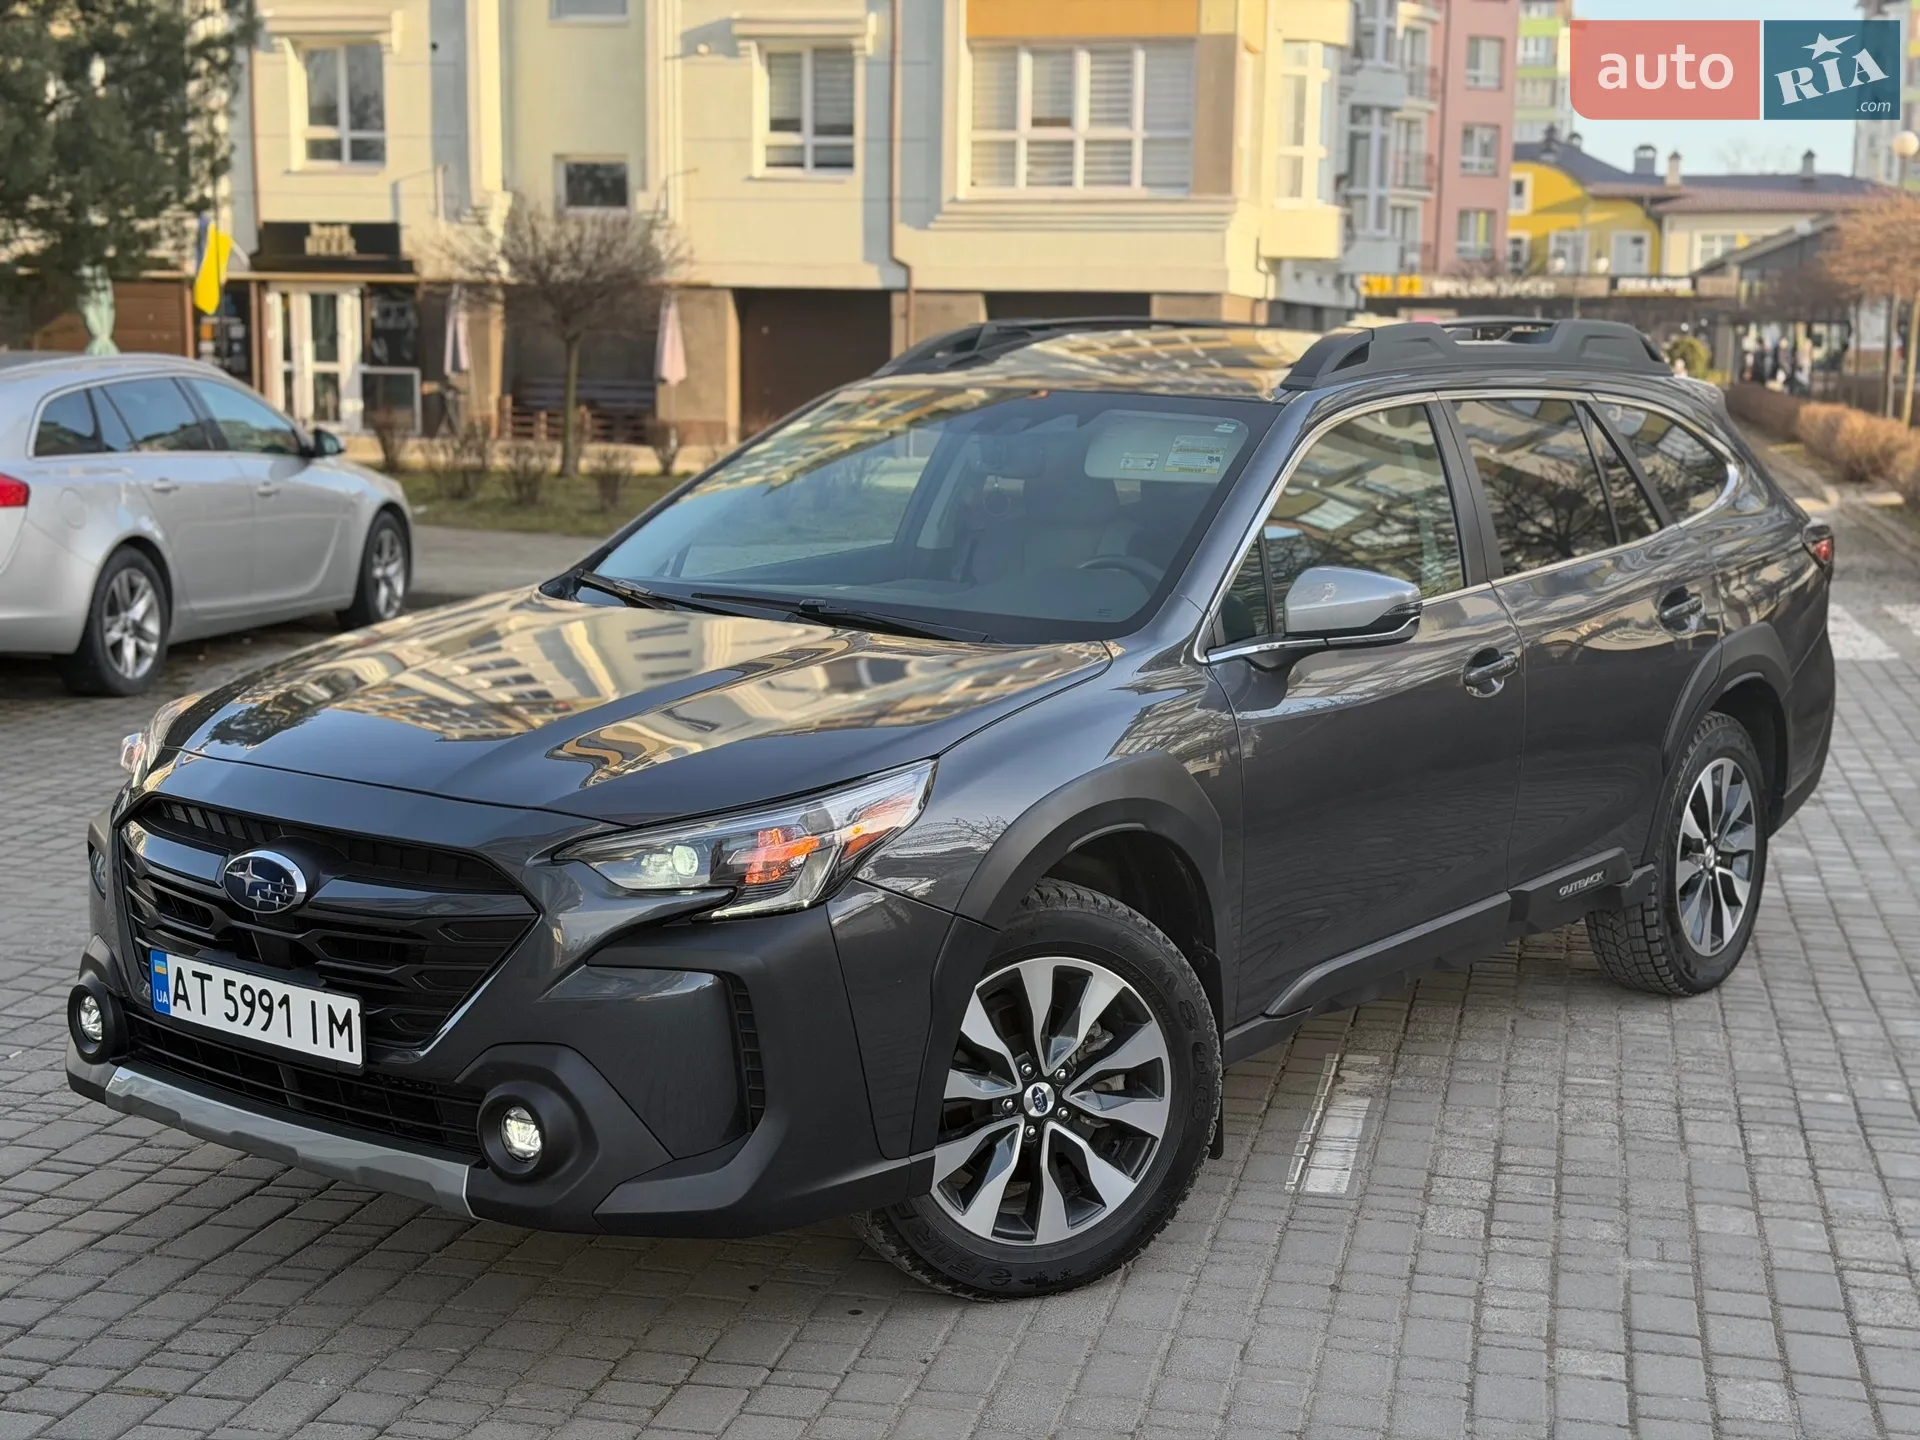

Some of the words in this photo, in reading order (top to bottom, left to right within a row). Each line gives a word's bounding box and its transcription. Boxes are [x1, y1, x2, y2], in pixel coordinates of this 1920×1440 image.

[1559, 871, 1604, 896] OUTBACK
[156, 989, 169, 1005] UA
[172, 966, 213, 1016] AT
[223, 978, 292, 1038] 5991
[310, 1000, 354, 1053] IM
